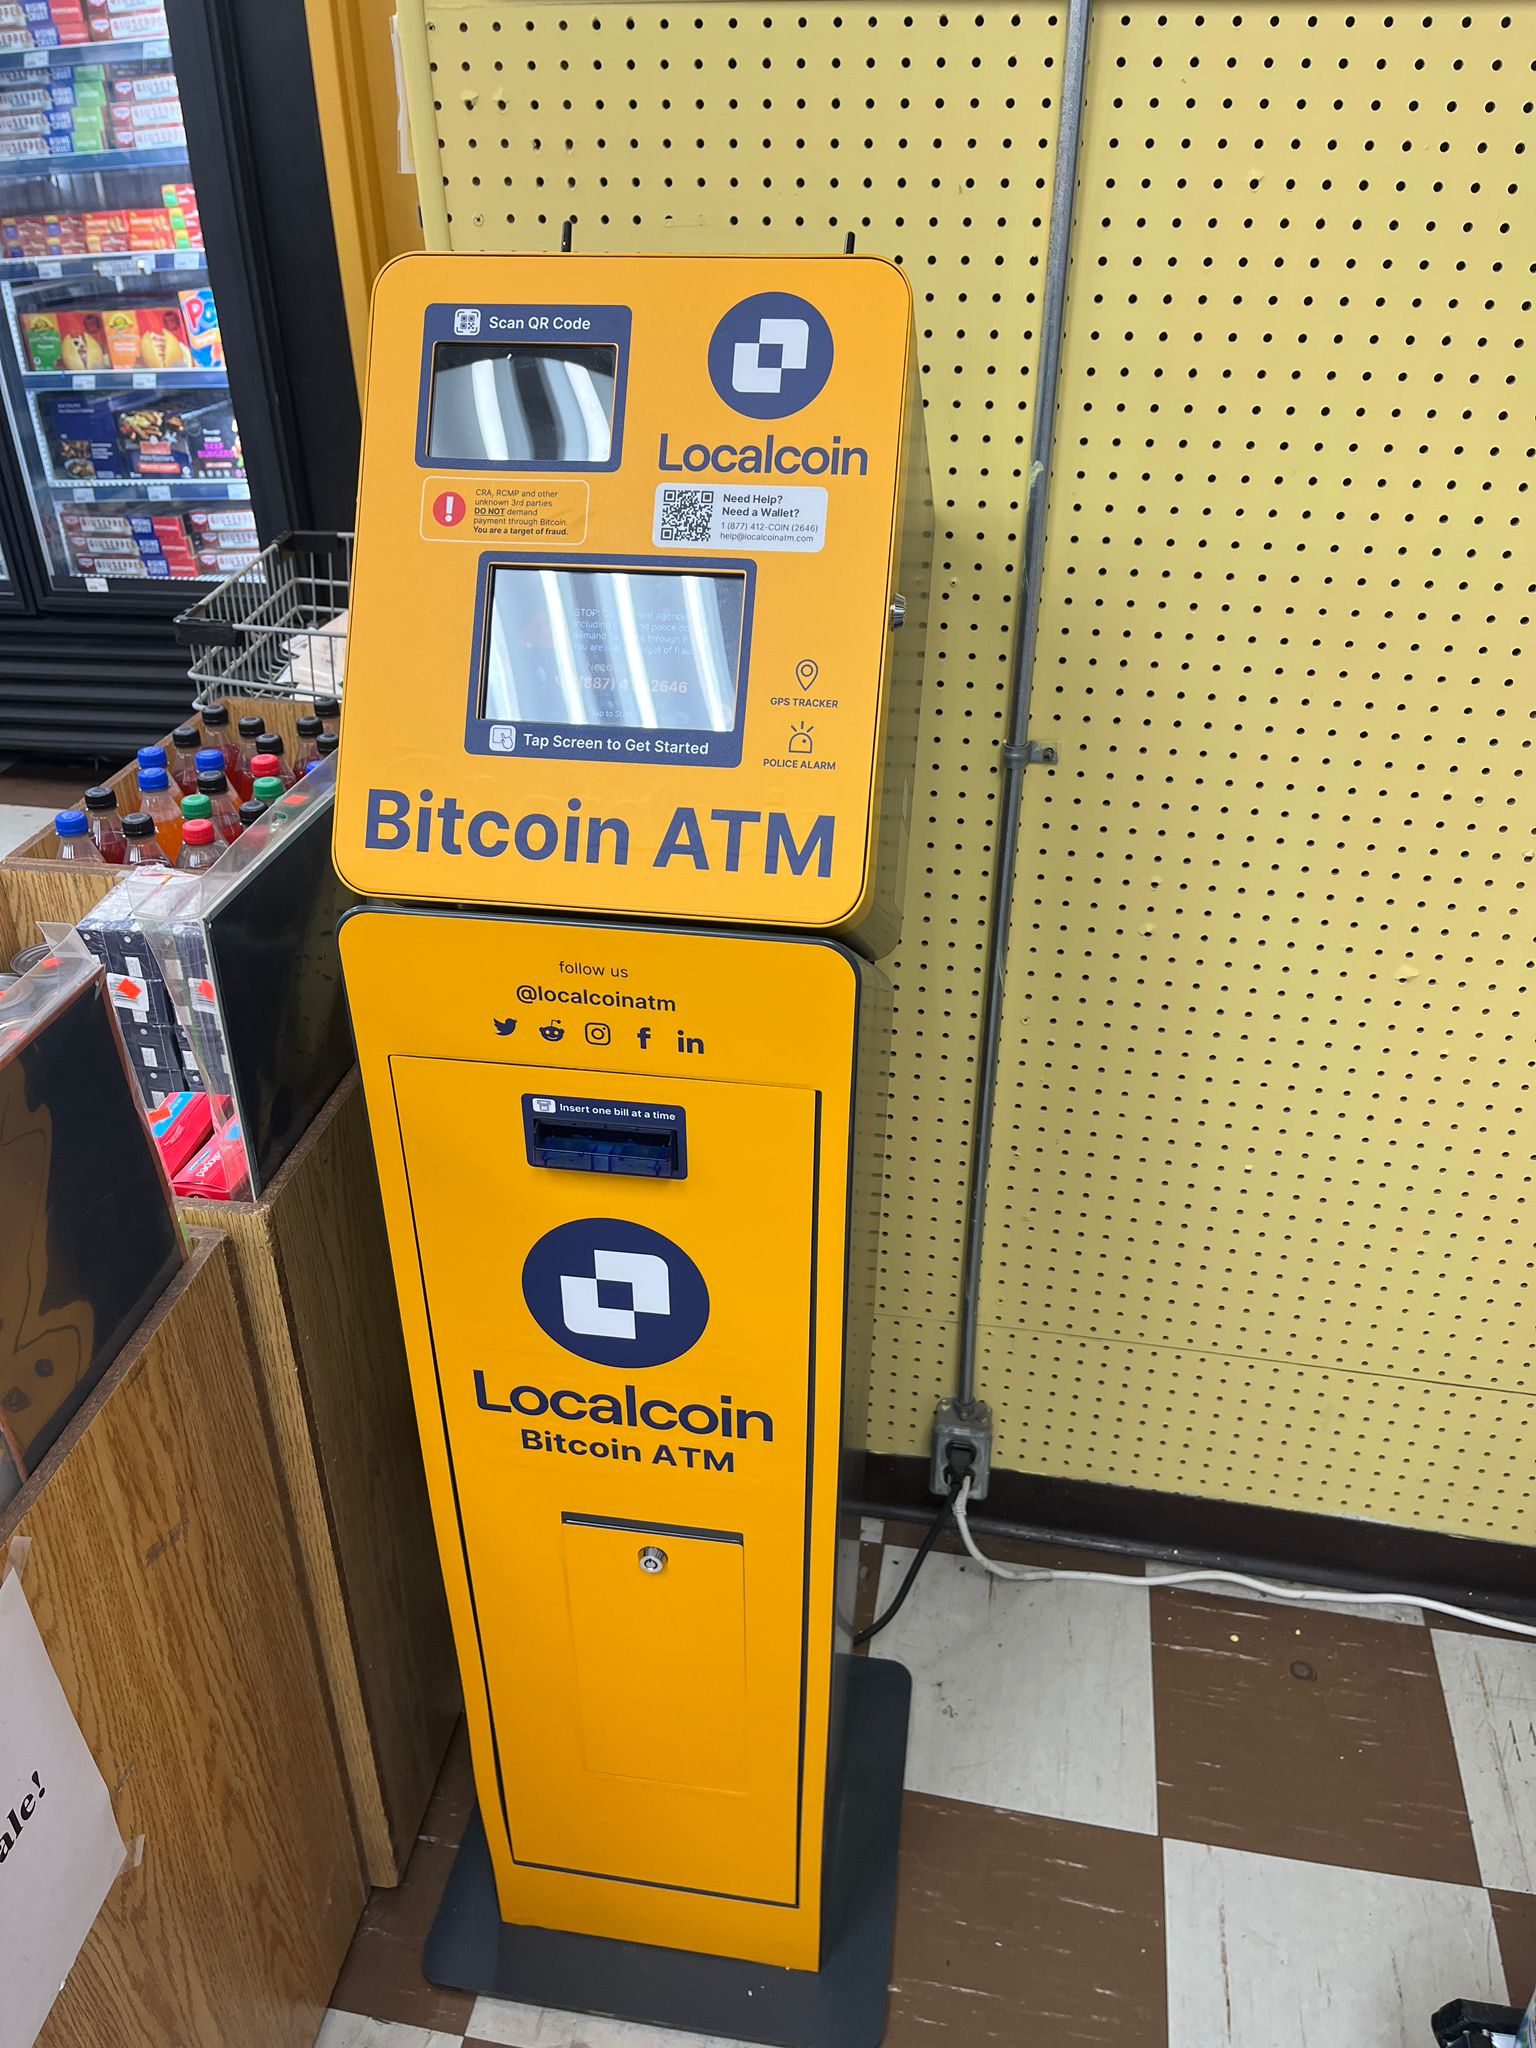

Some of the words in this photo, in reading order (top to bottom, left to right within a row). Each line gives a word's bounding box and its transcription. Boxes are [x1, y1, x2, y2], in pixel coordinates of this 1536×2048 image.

[489, 316, 524, 329] Scan
[528, 316, 549, 331] QR
[553, 317, 591, 330] Code
[658, 433, 868, 476] Localcoin
[475, 488, 494, 498] CRA,
[496, 489, 519, 497] RCMP
[521, 489, 536, 498] and
[537, 490, 558, 498] other
[474, 498, 509, 507] unknown
[510, 499, 524, 507] 3rd
[526, 499, 552, 509] parties
[723, 494, 750, 503] Need
[752, 494, 783, 505] Help?
[506, 508, 538, 516] demand
[722, 507, 749, 516] Need
[752, 509, 758, 517] a
[760, 507, 800, 518] Wallet?
[473, 518, 506, 526] payment
[508, 518, 538, 527] through
[539, 518, 568, 527] Bitcoin.
[727, 522, 748, 531] (877)
[750, 523, 789, 531] 412-COIN
[791, 524, 818, 533] (2646)
[473, 526, 487, 534] You
[510, 527, 534, 536] target
[535, 527, 544, 535] of
[545, 528, 568, 536] fraud.
[720, 532, 814, 542] help@localcoinatm.com
[651, 623, 677, 633] police
[770, 697, 790, 706] GPS
[793, 698, 838, 708] TRACKER
[524, 734, 549, 750] Tap
[552, 735, 603, 750] Screen
[606, 738, 622, 751] to
[624, 738, 651, 752] Get
[654, 739, 709, 755] Started
[763, 758, 799, 769] POLICE
[800, 760, 836, 770] ALARM
[364, 788, 630, 866] Bitcoin
[652, 806, 836, 878] ATM
[559, 960, 605, 976] follow
[610, 966, 629, 978] us
[516, 984, 676, 1012] @localcoinatm
[677, 1029, 705, 1054] in
[559, 1103, 590, 1115] Insert
[592, 1105, 611, 1115] one
[614, 1105, 629, 1117] bill
[631, 1108, 642, 1118] at
[644, 1111, 650, 1119] a
[653, 1109, 676, 1121] time
[473, 1369, 774, 1442] Localcoin
[521, 1428, 641, 1462] Bitcoin
[652, 1444, 734, 1473] ATM
